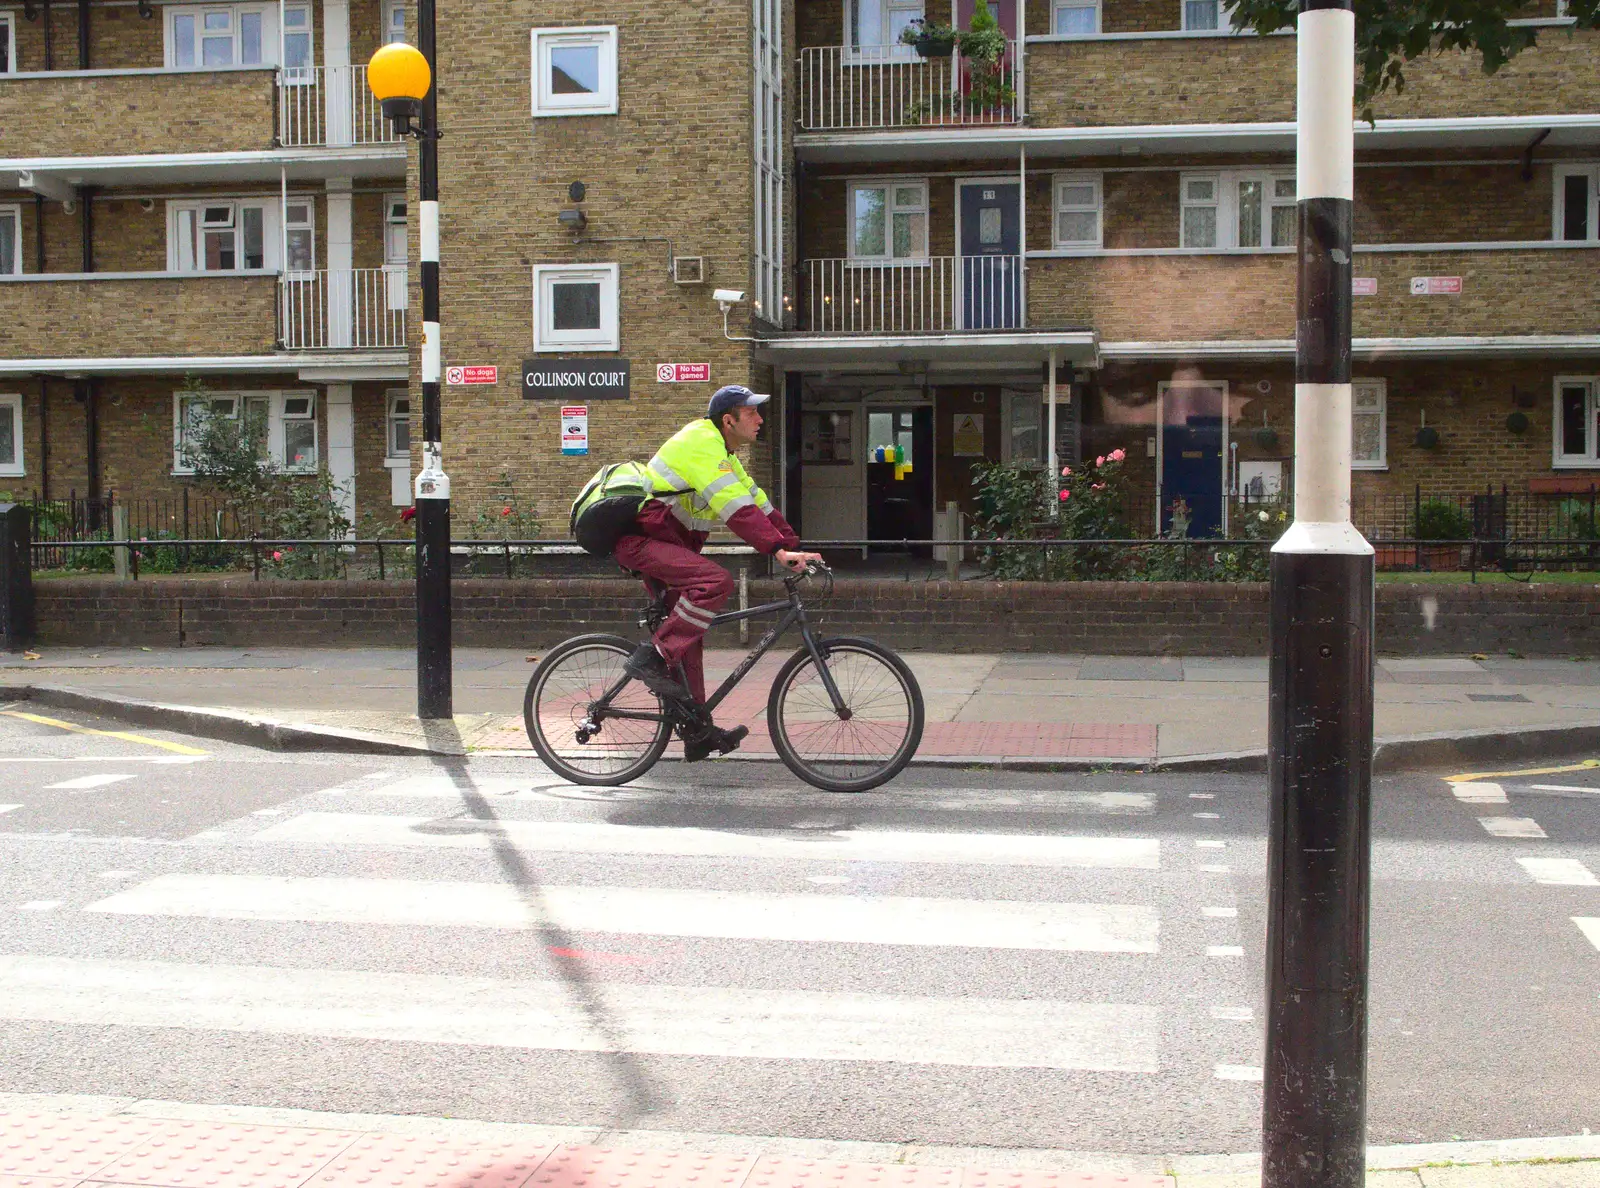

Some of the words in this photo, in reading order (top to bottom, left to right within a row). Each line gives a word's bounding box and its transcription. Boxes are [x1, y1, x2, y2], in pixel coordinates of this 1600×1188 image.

[477, 369, 494, 377] dogs
[526, 372, 586, 387] COLLINSON
[588, 372, 626, 387] COURT
